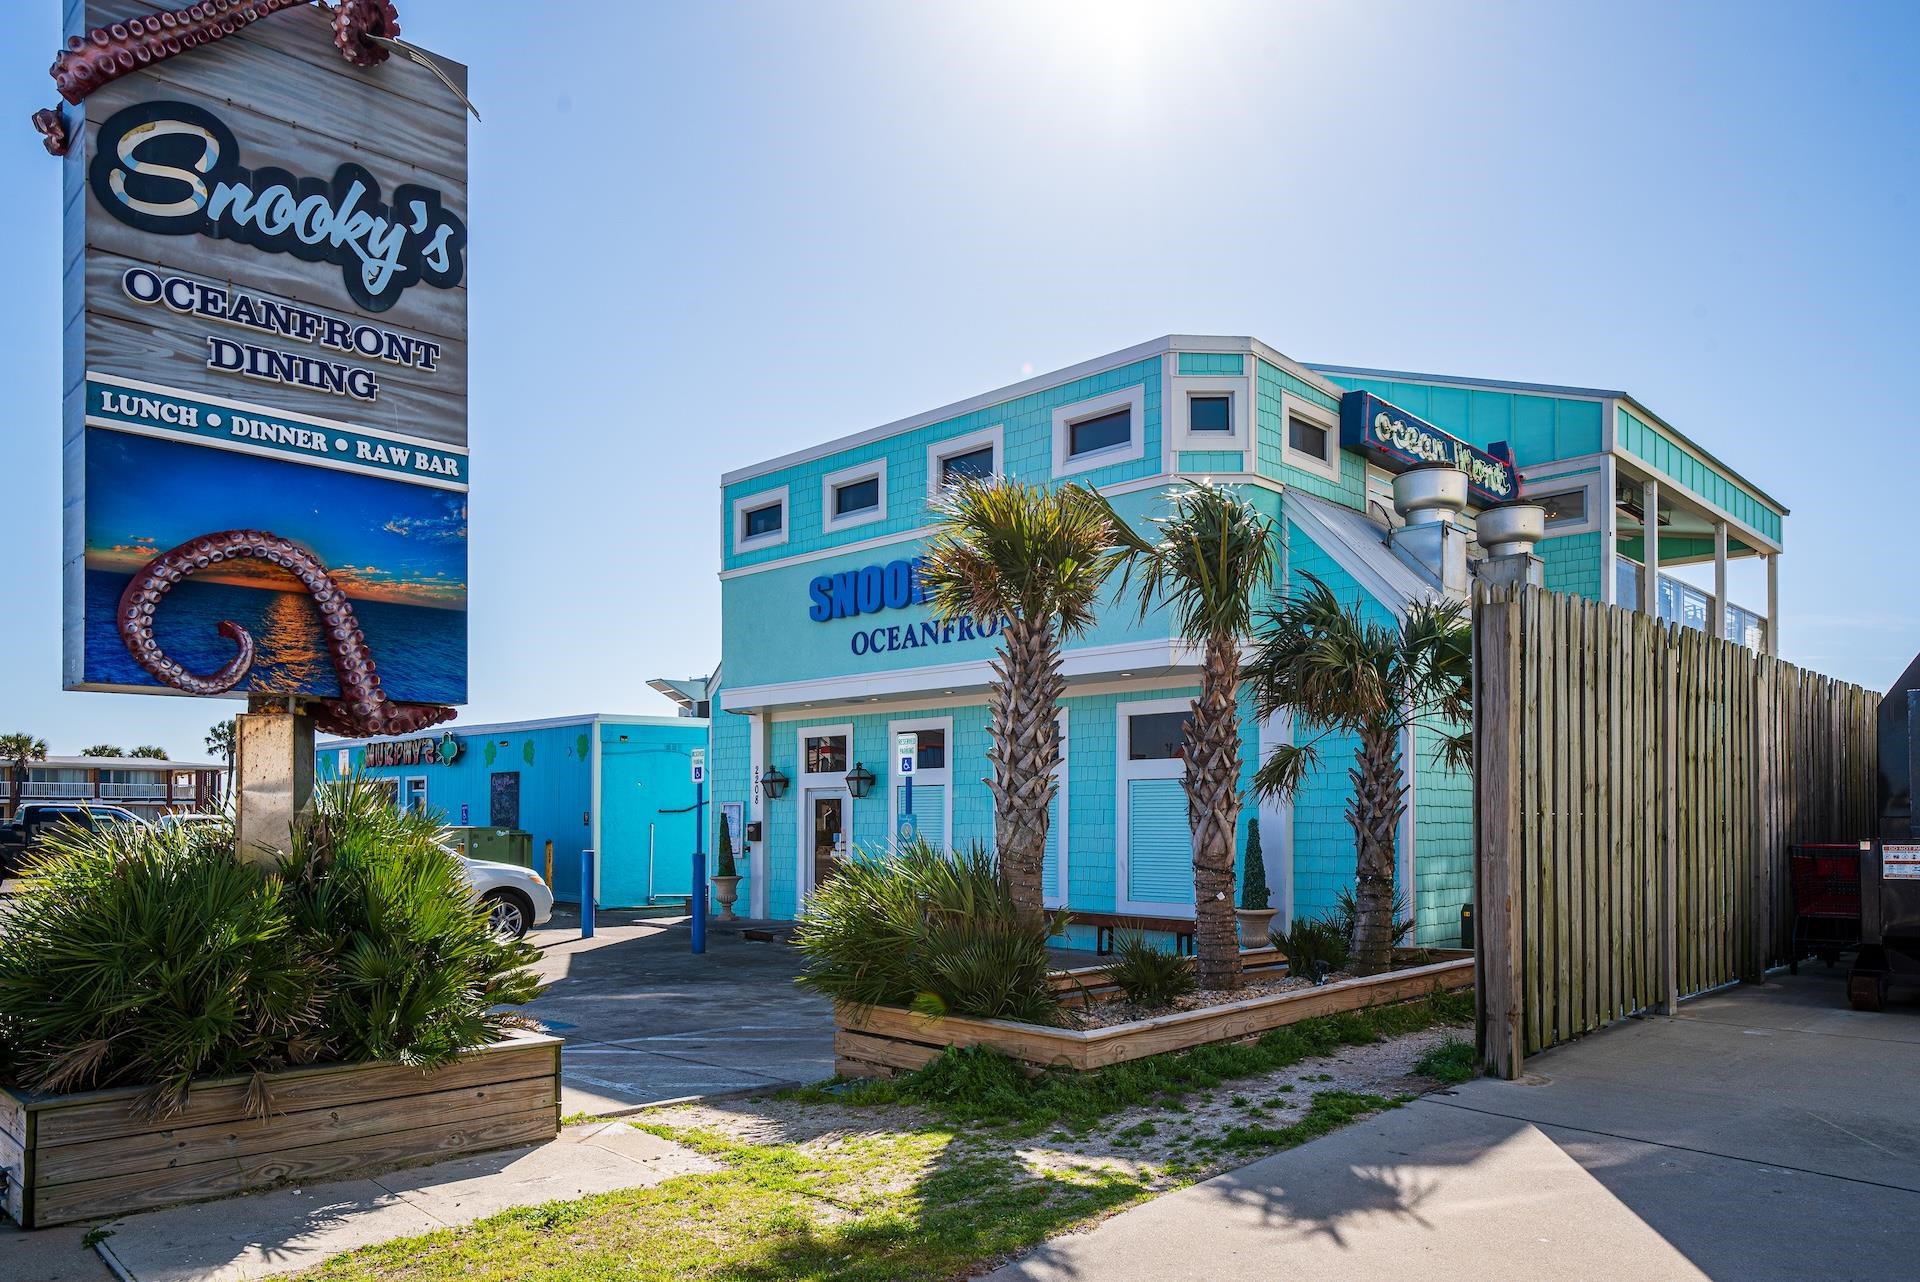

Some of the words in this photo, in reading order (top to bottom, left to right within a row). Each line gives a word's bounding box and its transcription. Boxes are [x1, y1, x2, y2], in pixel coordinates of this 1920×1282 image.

[109, 120, 454, 295] Snooky's
[122, 266, 440, 371] OCEANFRONT
[207, 336, 378, 401] DINING
[101, 390, 198, 427] LUNCH
[231, 415, 328, 452] DINNER
[356, 440, 409, 466] RAW
[414, 451, 459, 477] BAR
[366, 738, 434, 767] MURPHY'S
